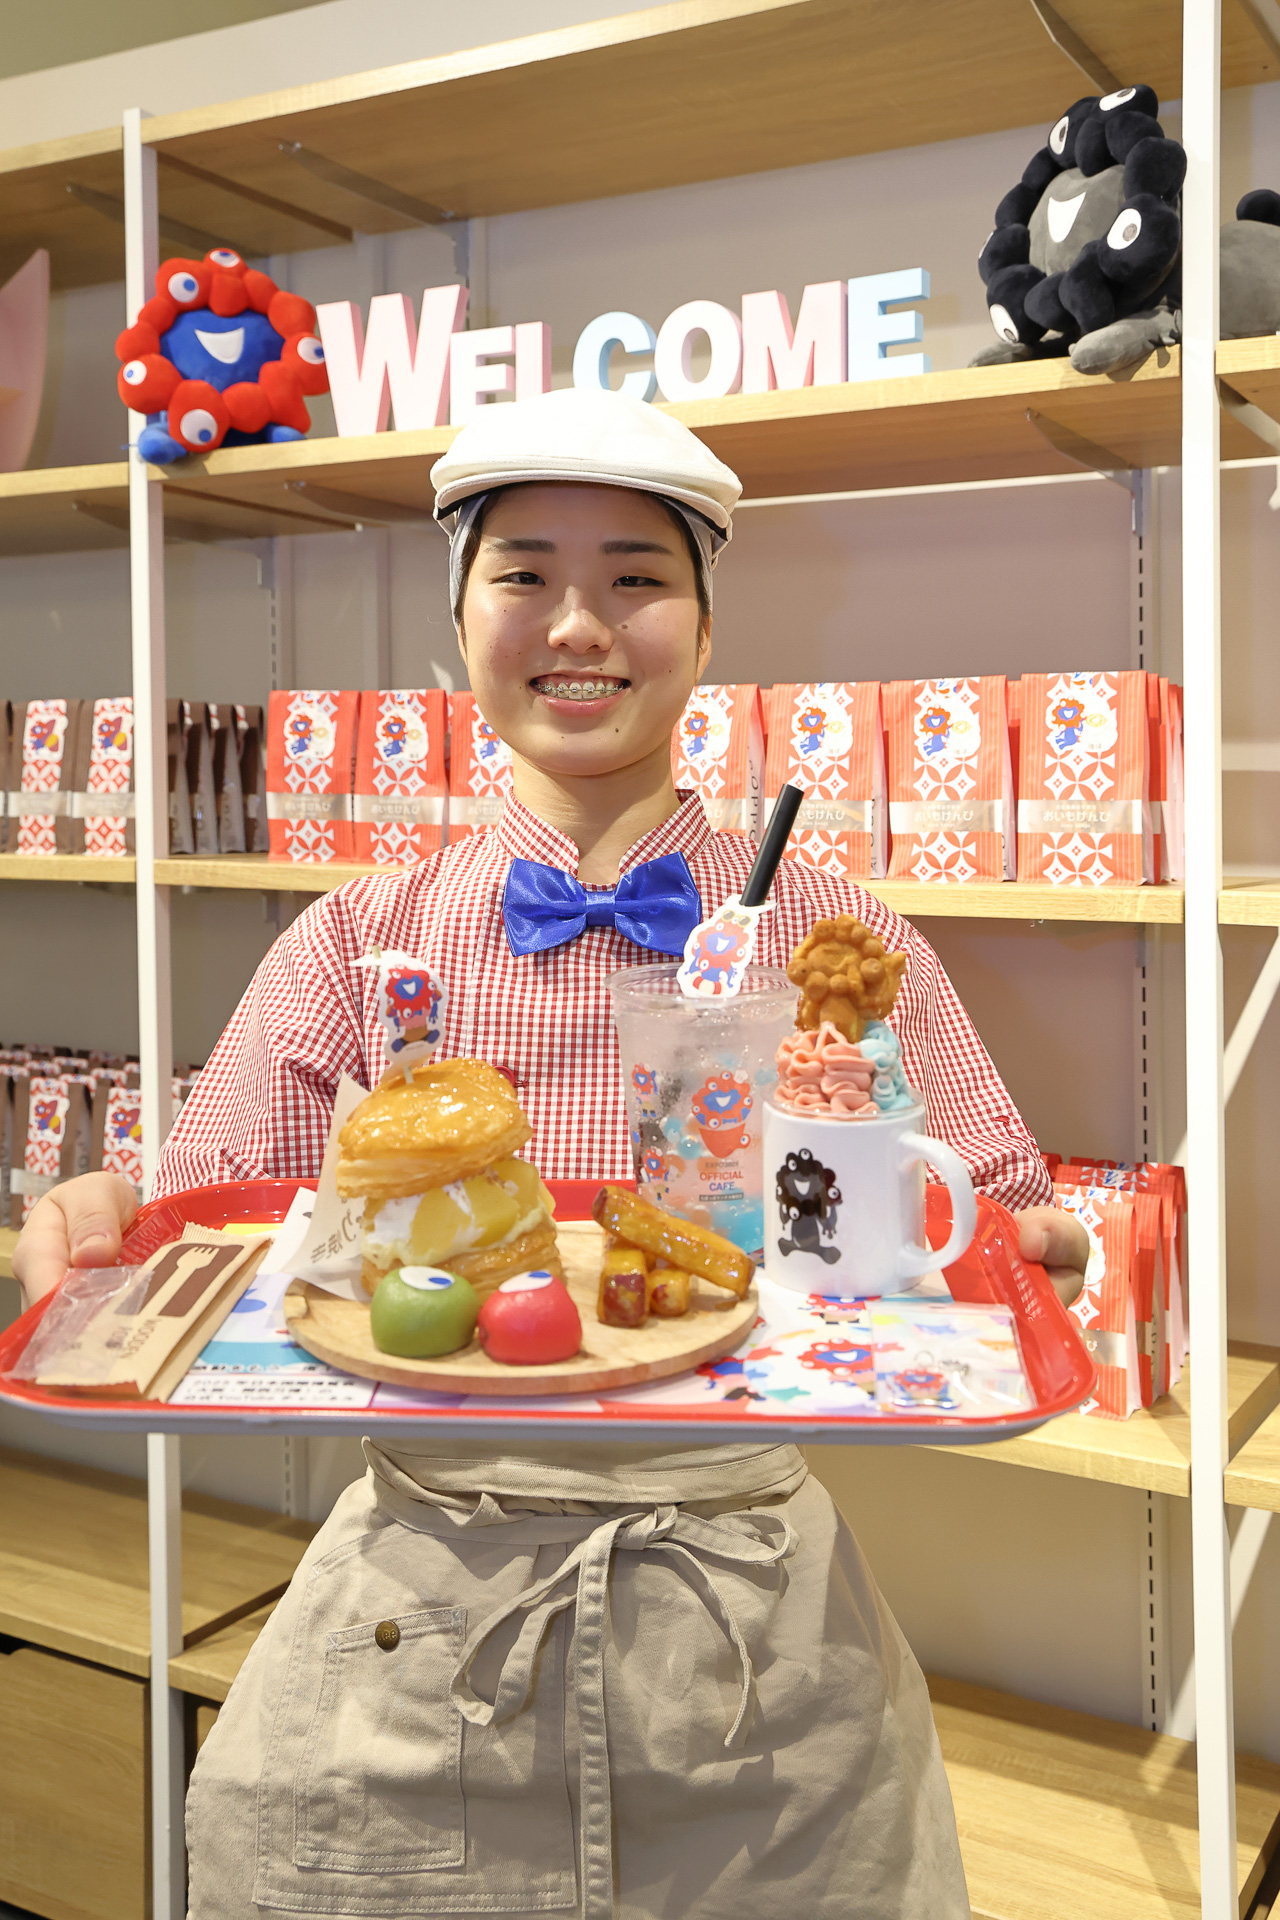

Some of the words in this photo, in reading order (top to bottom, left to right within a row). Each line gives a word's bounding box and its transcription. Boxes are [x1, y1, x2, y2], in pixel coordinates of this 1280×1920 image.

[796, 810, 846, 822] いもけんぴ
[699, 1170, 744, 1181] OFFICIAL
[709, 1181, 735, 1191] CAFE
